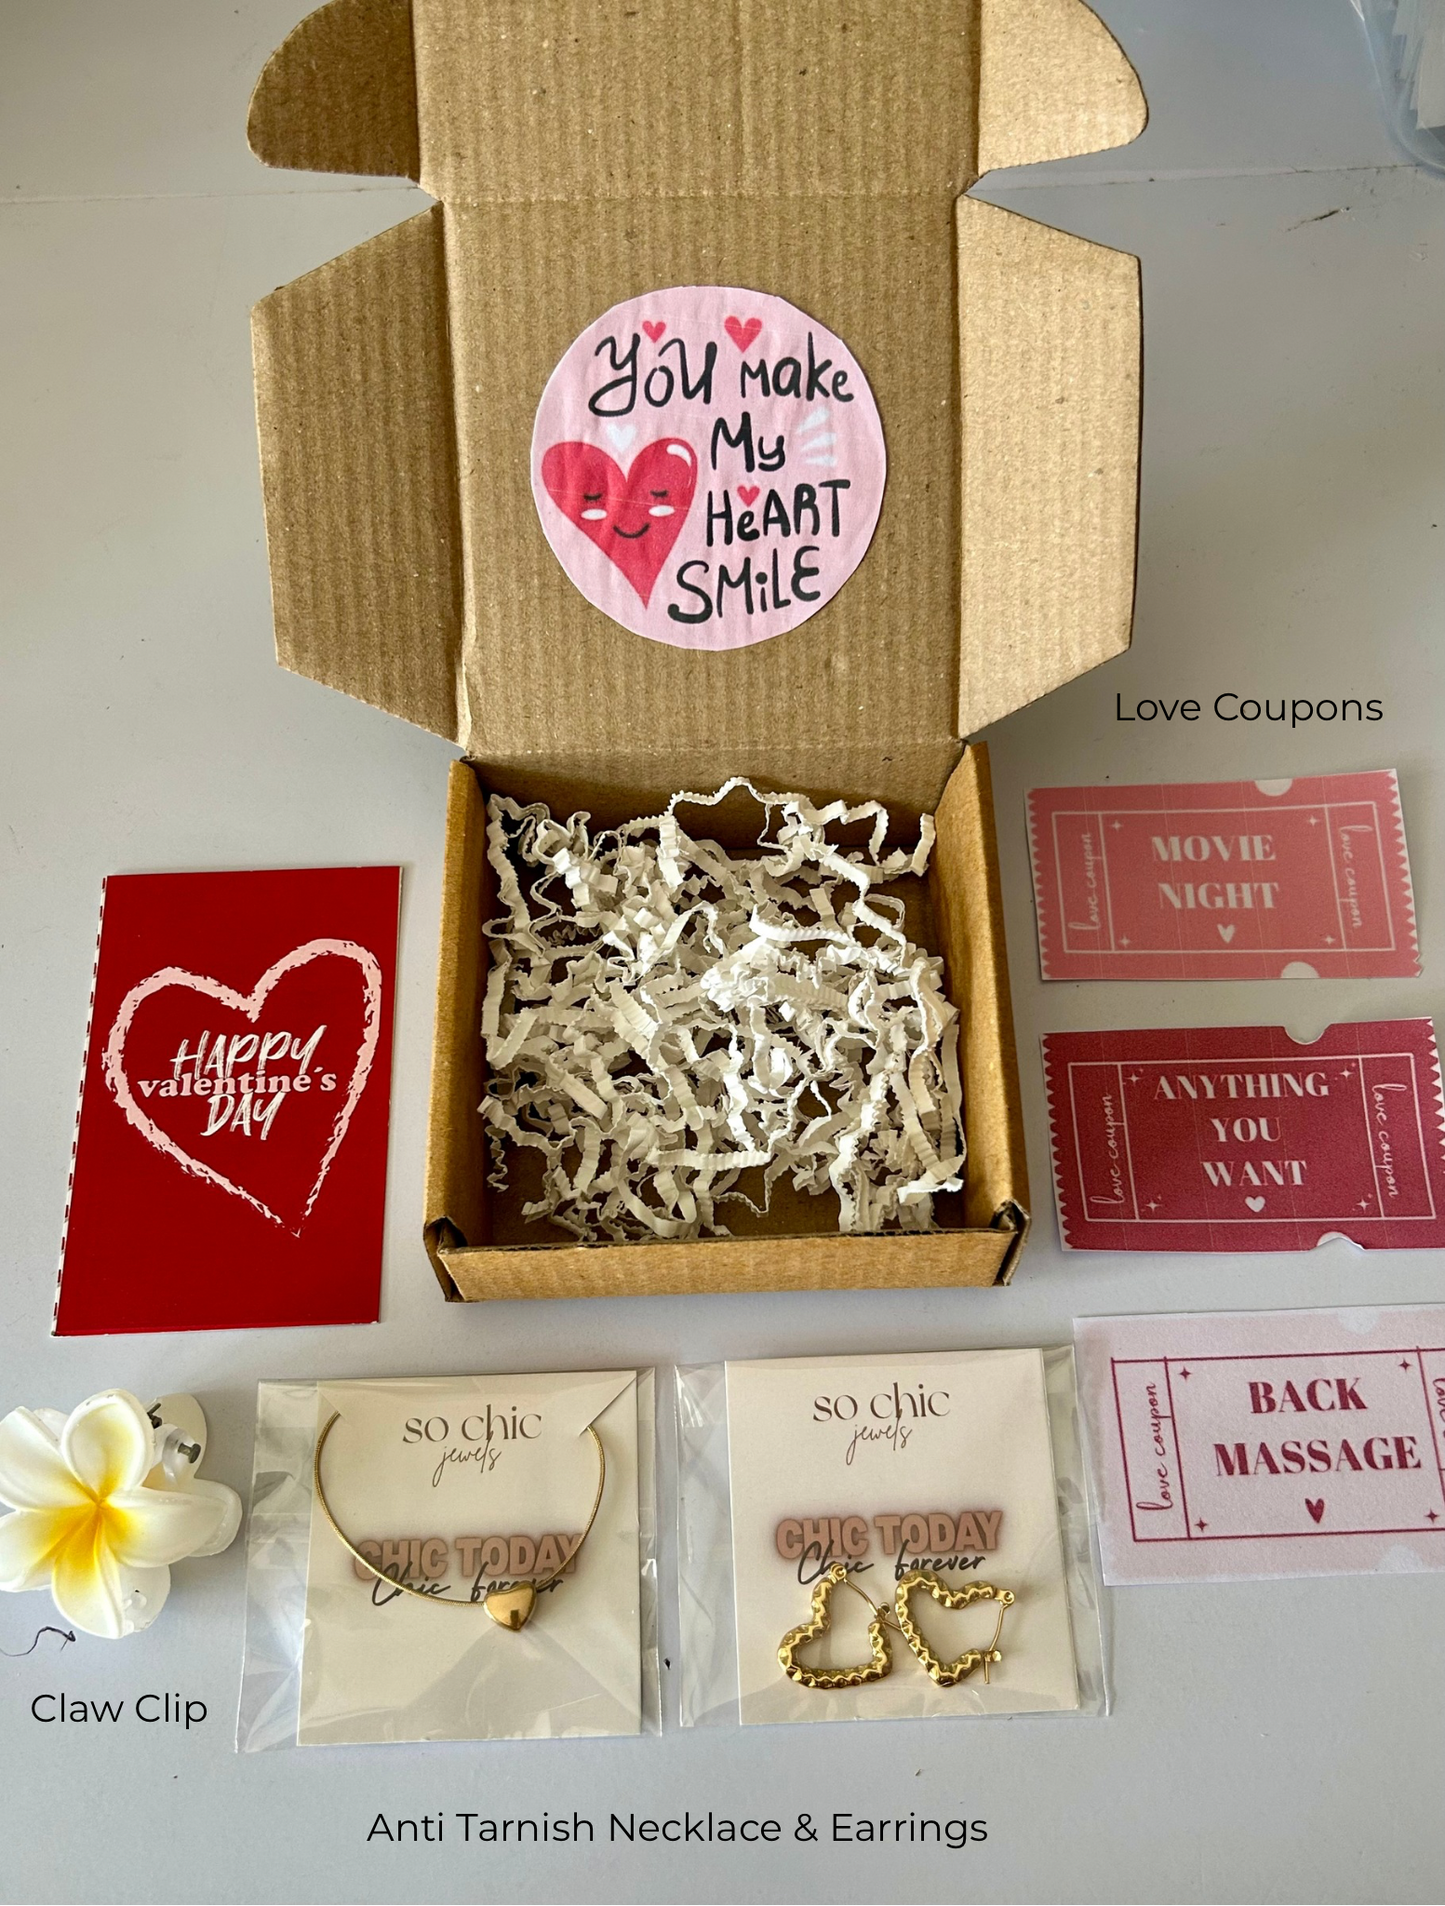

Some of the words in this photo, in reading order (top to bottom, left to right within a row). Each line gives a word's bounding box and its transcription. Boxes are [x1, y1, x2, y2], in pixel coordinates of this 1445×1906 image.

[740, 332, 854, 403] make
[710, 411, 785, 473] My
[705, 479, 850, 547] HeART
[667, 545, 821, 624] SMiLE
[1080, 833, 1102, 889] coupon
[1151, 834, 1277, 862] MOVIE
[1339, 825, 1373, 864] love
[1067, 894, 1102, 931] love
[1158, 882, 1279, 910] NIGHT
[1339, 867, 1362, 930] coupon
[170, 1024, 327, 1080] HAPPY
[1154, 1071, 1329, 1100] ANYTHING
[1372, 1082, 1408, 1126] love
[200, 1091, 287, 1141] DAY
[1101, 1092, 1125, 1160] coupon
[1211, 1116, 1282, 1143] YOU
[1090, 1165, 1125, 1206] love
[1202, 1160, 1308, 1187] WANT
[1375, 1130, 1399, 1199] coupon
[812, 1394, 858, 1422] so
[870, 1382, 951, 1419] chic
[1248, 1376, 1368, 1415] BACK
[402, 1416, 449, 1444] so
[461, 1404, 542, 1442] chic
[846, 1409, 913, 1466] jewels
[1145, 1382, 1172, 1457] coupon
[432, 1432, 502, 1488] jewels
[1213, 1435, 1422, 1477] MASSAGE
[1136, 1463, 1174, 1511] love
[354, 1538, 448, 1580] CHIC
[455, 1533, 583, 1577] TODAY
[776, 1514, 869, 1559] CHIC
[874, 1510, 1003, 1555] TODAY
[798, 1538, 875, 1585] Chic
[894, 1538, 986, 1581] forever
